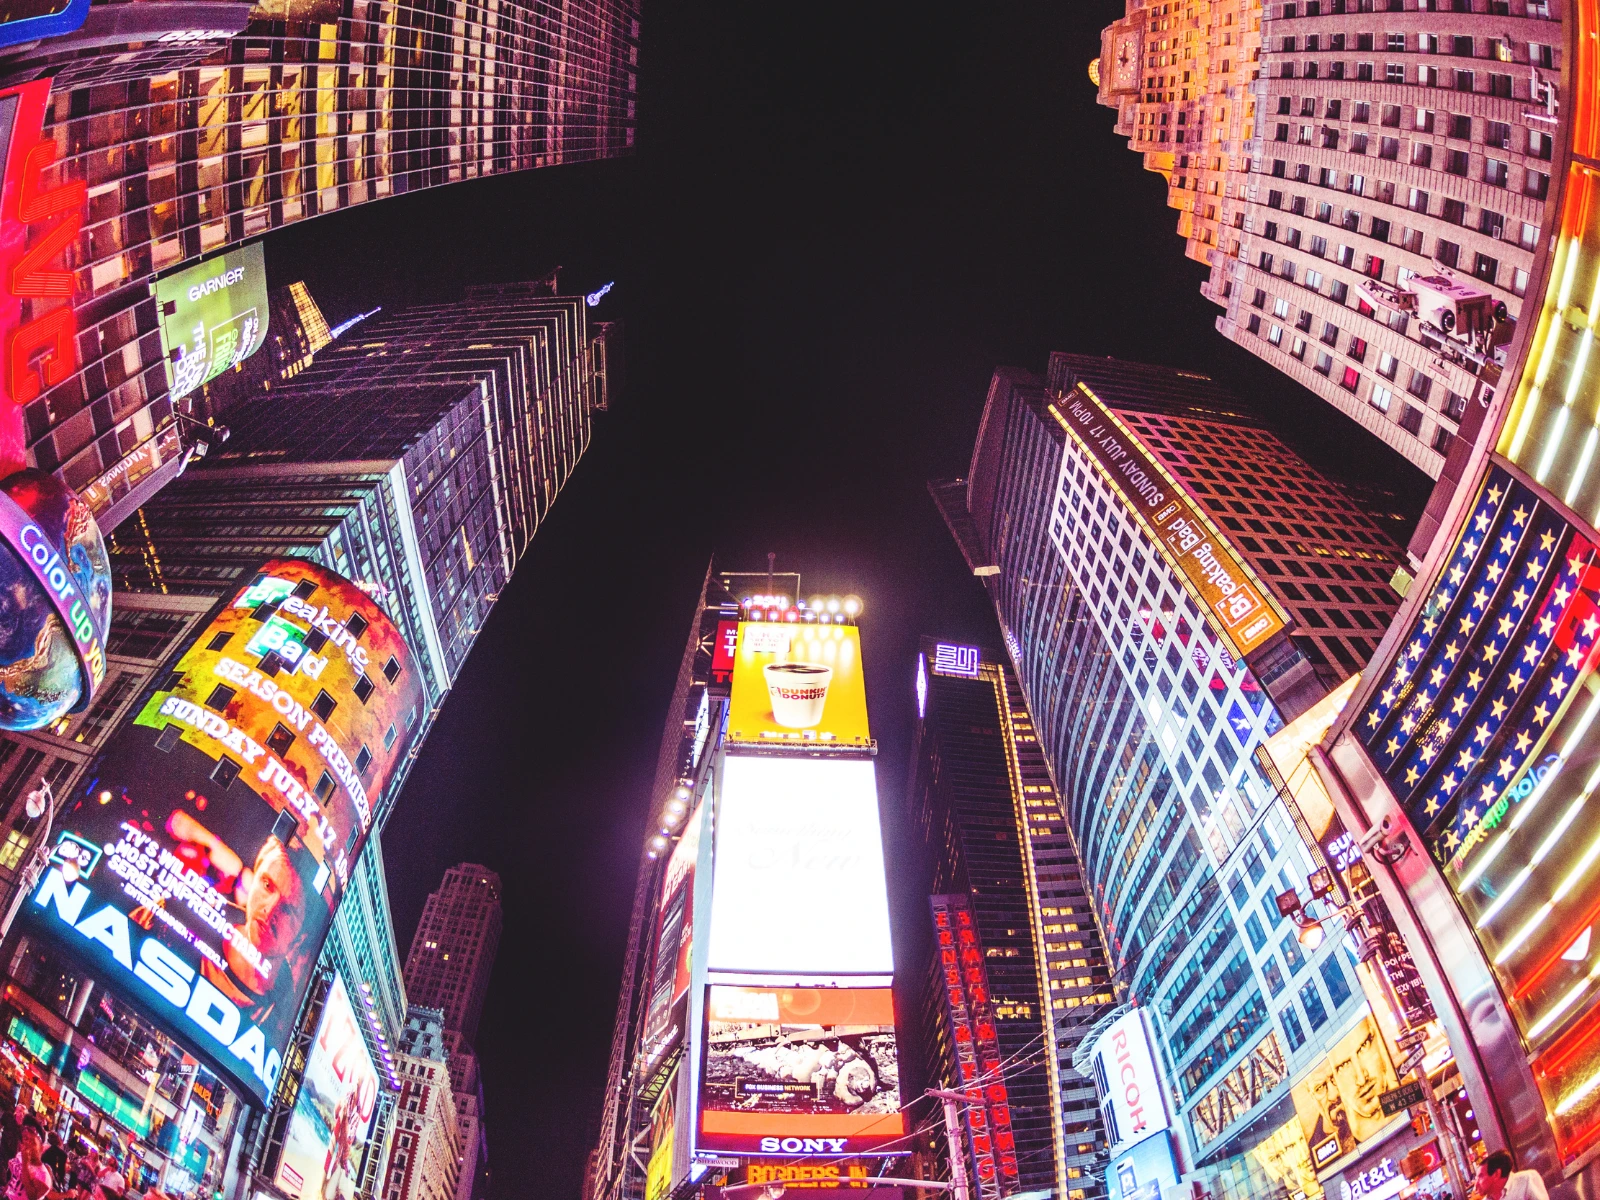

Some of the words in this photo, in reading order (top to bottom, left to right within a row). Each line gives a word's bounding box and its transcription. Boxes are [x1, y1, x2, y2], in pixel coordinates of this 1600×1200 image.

[12, 138, 87, 404] JVC
[188, 267, 245, 301] GARNIER
[1068, 400, 1094, 425] 10PM
[1089, 425, 1106, 438] 17
[1098, 436, 1127, 461] JULY
[1118, 459, 1165, 507] SUNDAY
[1167, 517, 1200, 551] Bad
[19, 524, 75, 601] Color
[69, 600, 94, 643] up
[1192, 542, 1252, 620] Breaking
[251, 583, 370, 676] Breaking
[261, 625, 328, 681] Bad
[782, 692, 825, 700] DONUTS
[160, 695, 265, 766] SUNDAY
[258, 758, 320, 822] JULY
[214, 657, 312, 732] SEASON
[308, 721, 372, 835] PREMIERE
[114, 838, 159, 876] MOST
[157, 869, 273, 980] UNPREDICTABLE
[937, 911, 961, 1005] ERNST
[1112, 1028, 1147, 1134] RICOH
[760, 1137, 848, 1153] SONY
[961, 1062, 995, 1180] YOUNG
[697, 1158, 738, 1167] SHERWOOD
[747, 1165, 840, 1188] BORDERS
[1351, 1157, 1395, 1198] at&t
